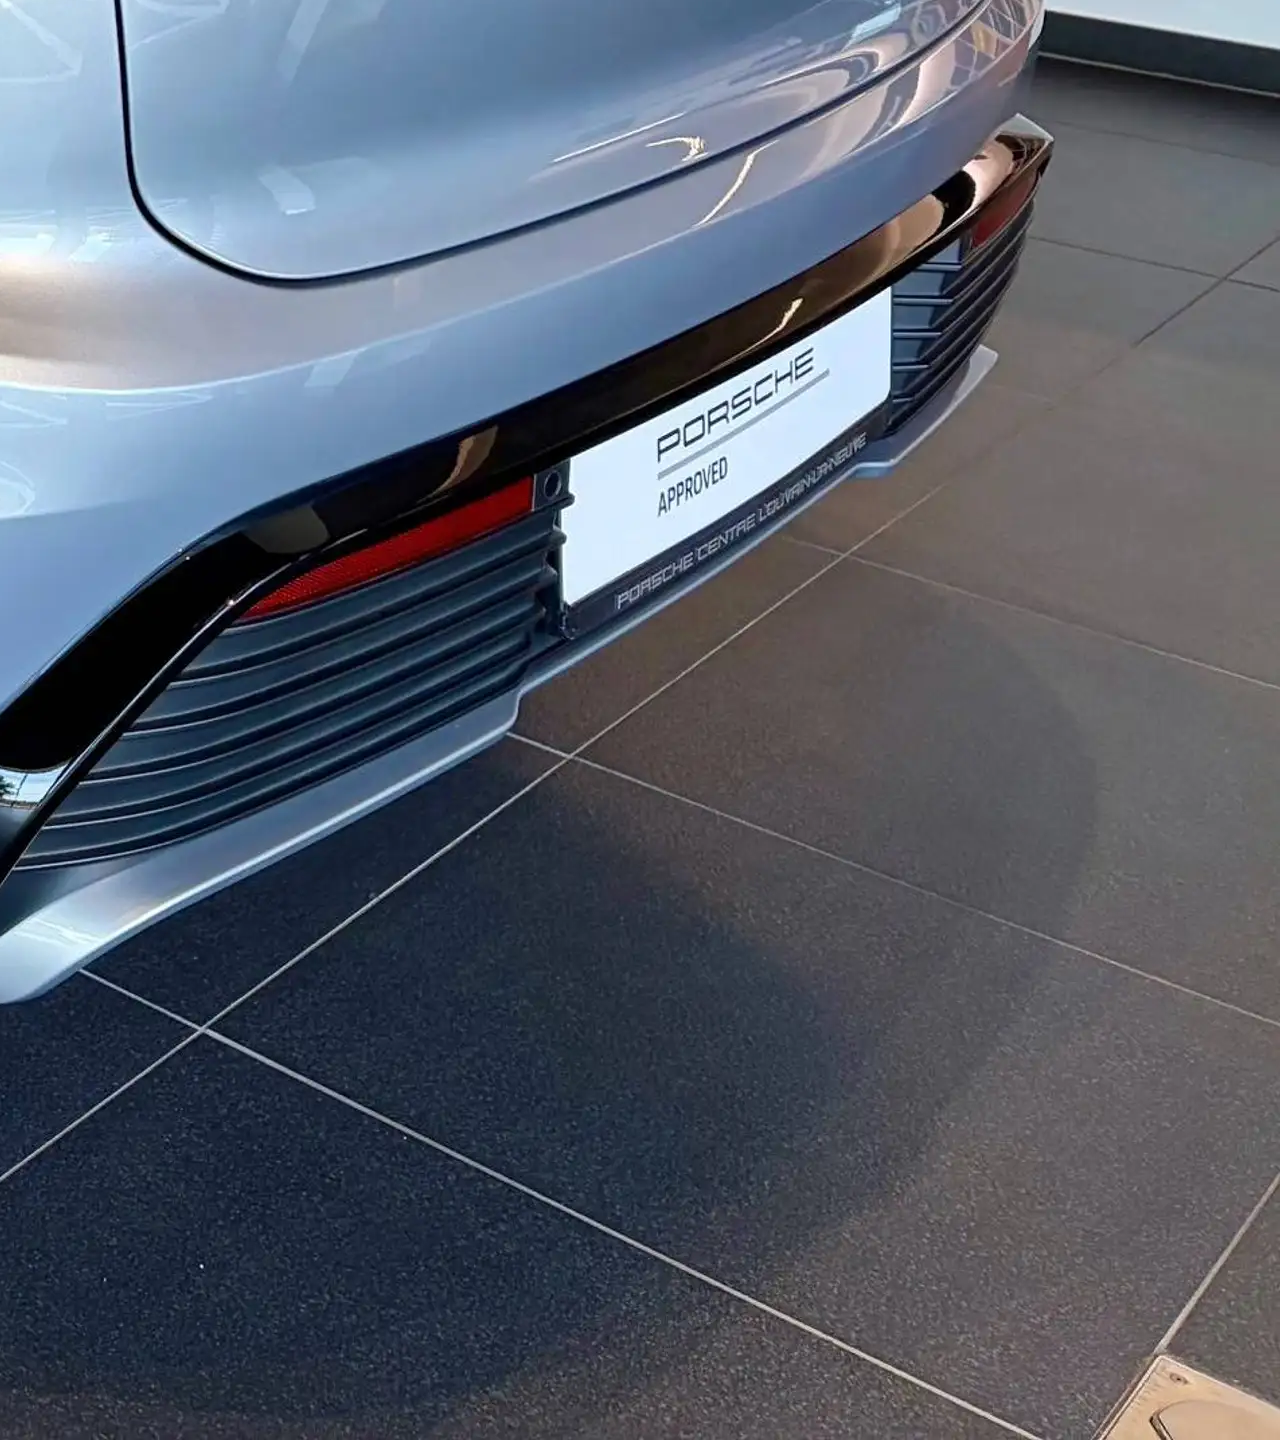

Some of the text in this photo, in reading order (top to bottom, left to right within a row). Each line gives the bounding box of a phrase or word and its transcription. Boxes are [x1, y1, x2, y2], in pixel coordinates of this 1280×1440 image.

[657, 347, 815, 464] PORSCHE
[616, 431, 868, 610] PORSCHE CENTRE LOUVAIN-LA-NEUVE
[657, 456, 729, 517] APPROVED
